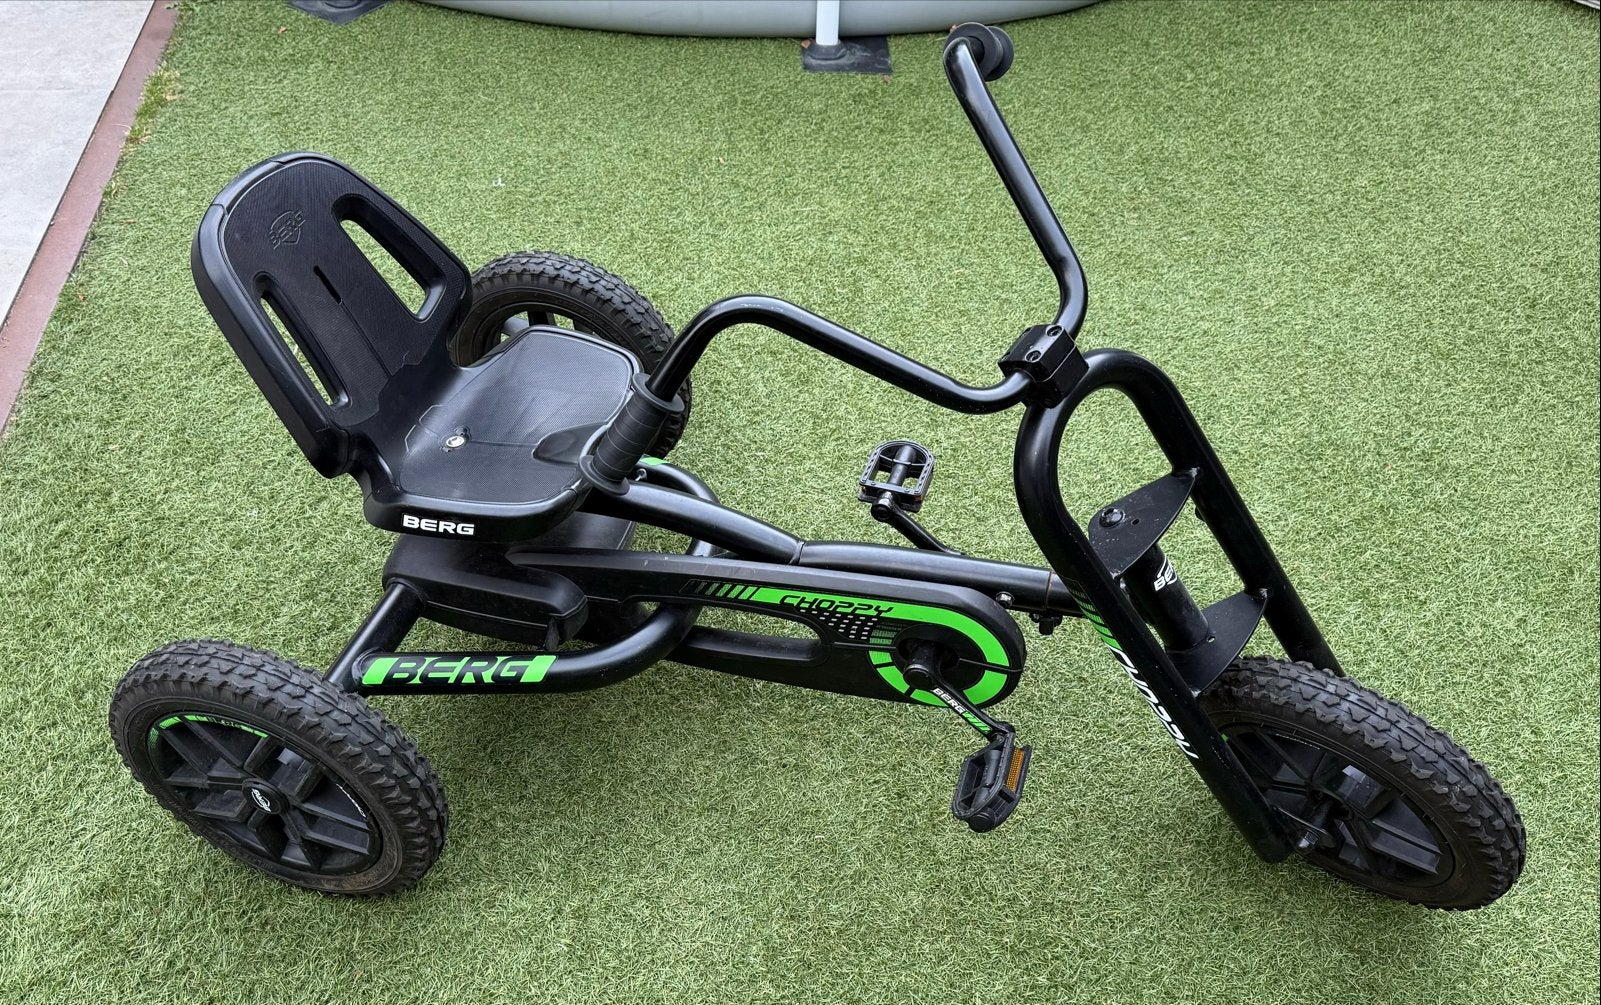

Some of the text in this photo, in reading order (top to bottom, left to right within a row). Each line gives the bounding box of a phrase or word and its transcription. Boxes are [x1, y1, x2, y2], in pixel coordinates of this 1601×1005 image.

[403, 514, 475, 536] BERG
[1153, 563, 1174, 591] BE
[779, 594, 894, 617] CHOPPY
[380, 655, 532, 685] BERG
[932, 687, 967, 715] BERG
